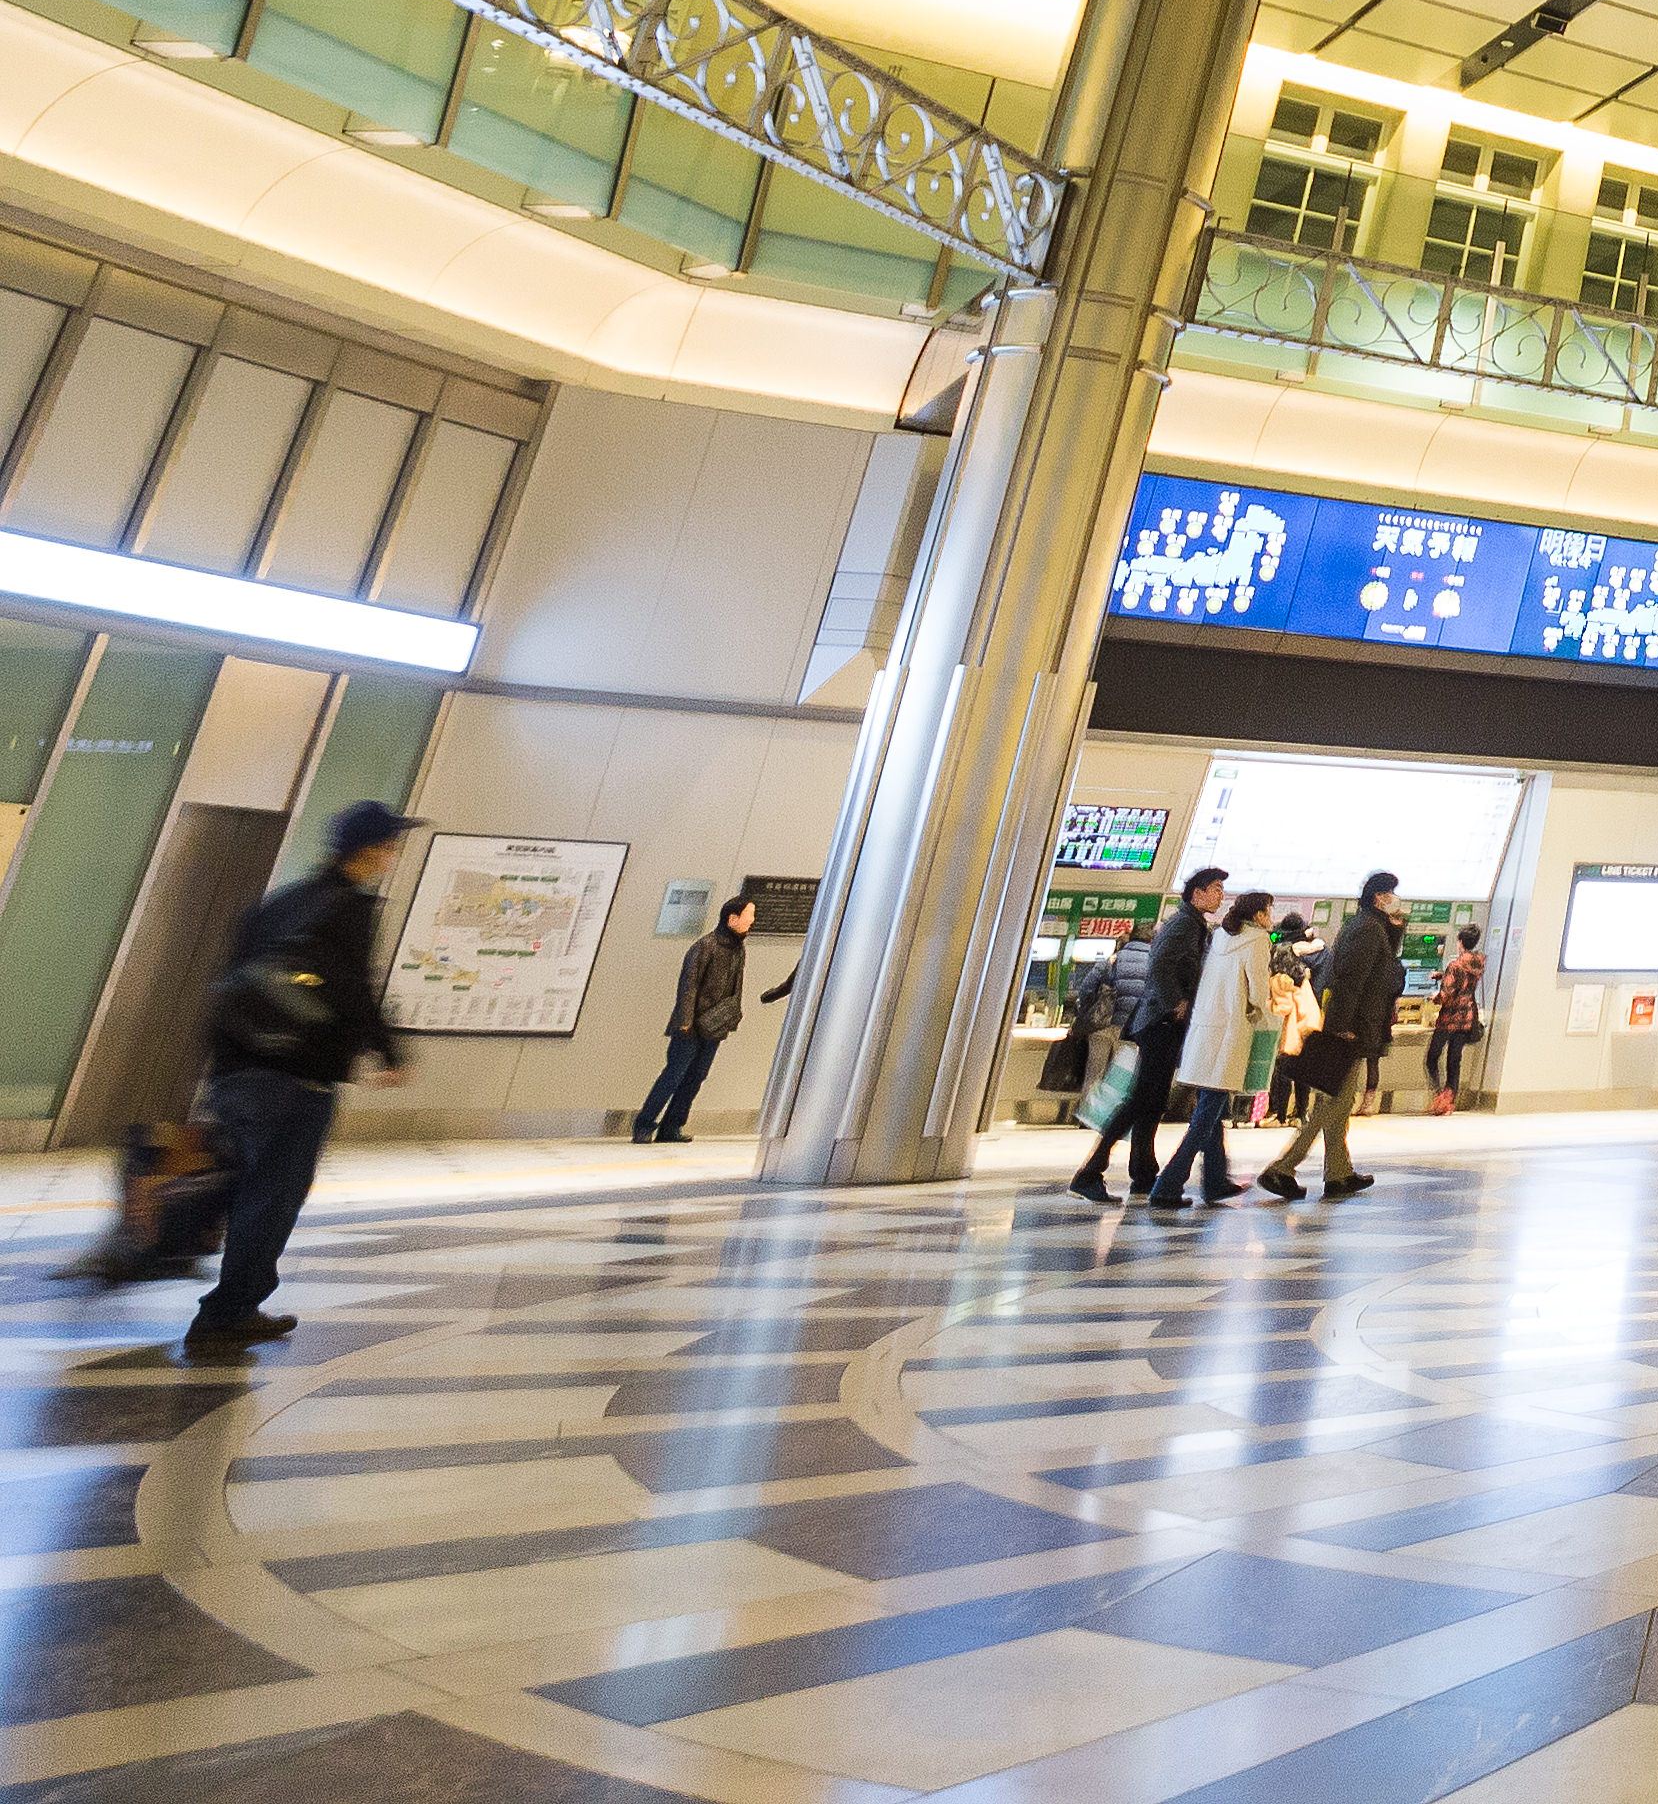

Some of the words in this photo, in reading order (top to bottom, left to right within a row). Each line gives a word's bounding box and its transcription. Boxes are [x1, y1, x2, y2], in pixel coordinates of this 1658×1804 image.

[1372, 524, 1479, 563] 天気予報
[1539, 529, 1607, 563] 明後日
[1623, 866, 1654, 877] TICKET
[1100, 898, 1138, 911] 定期券
